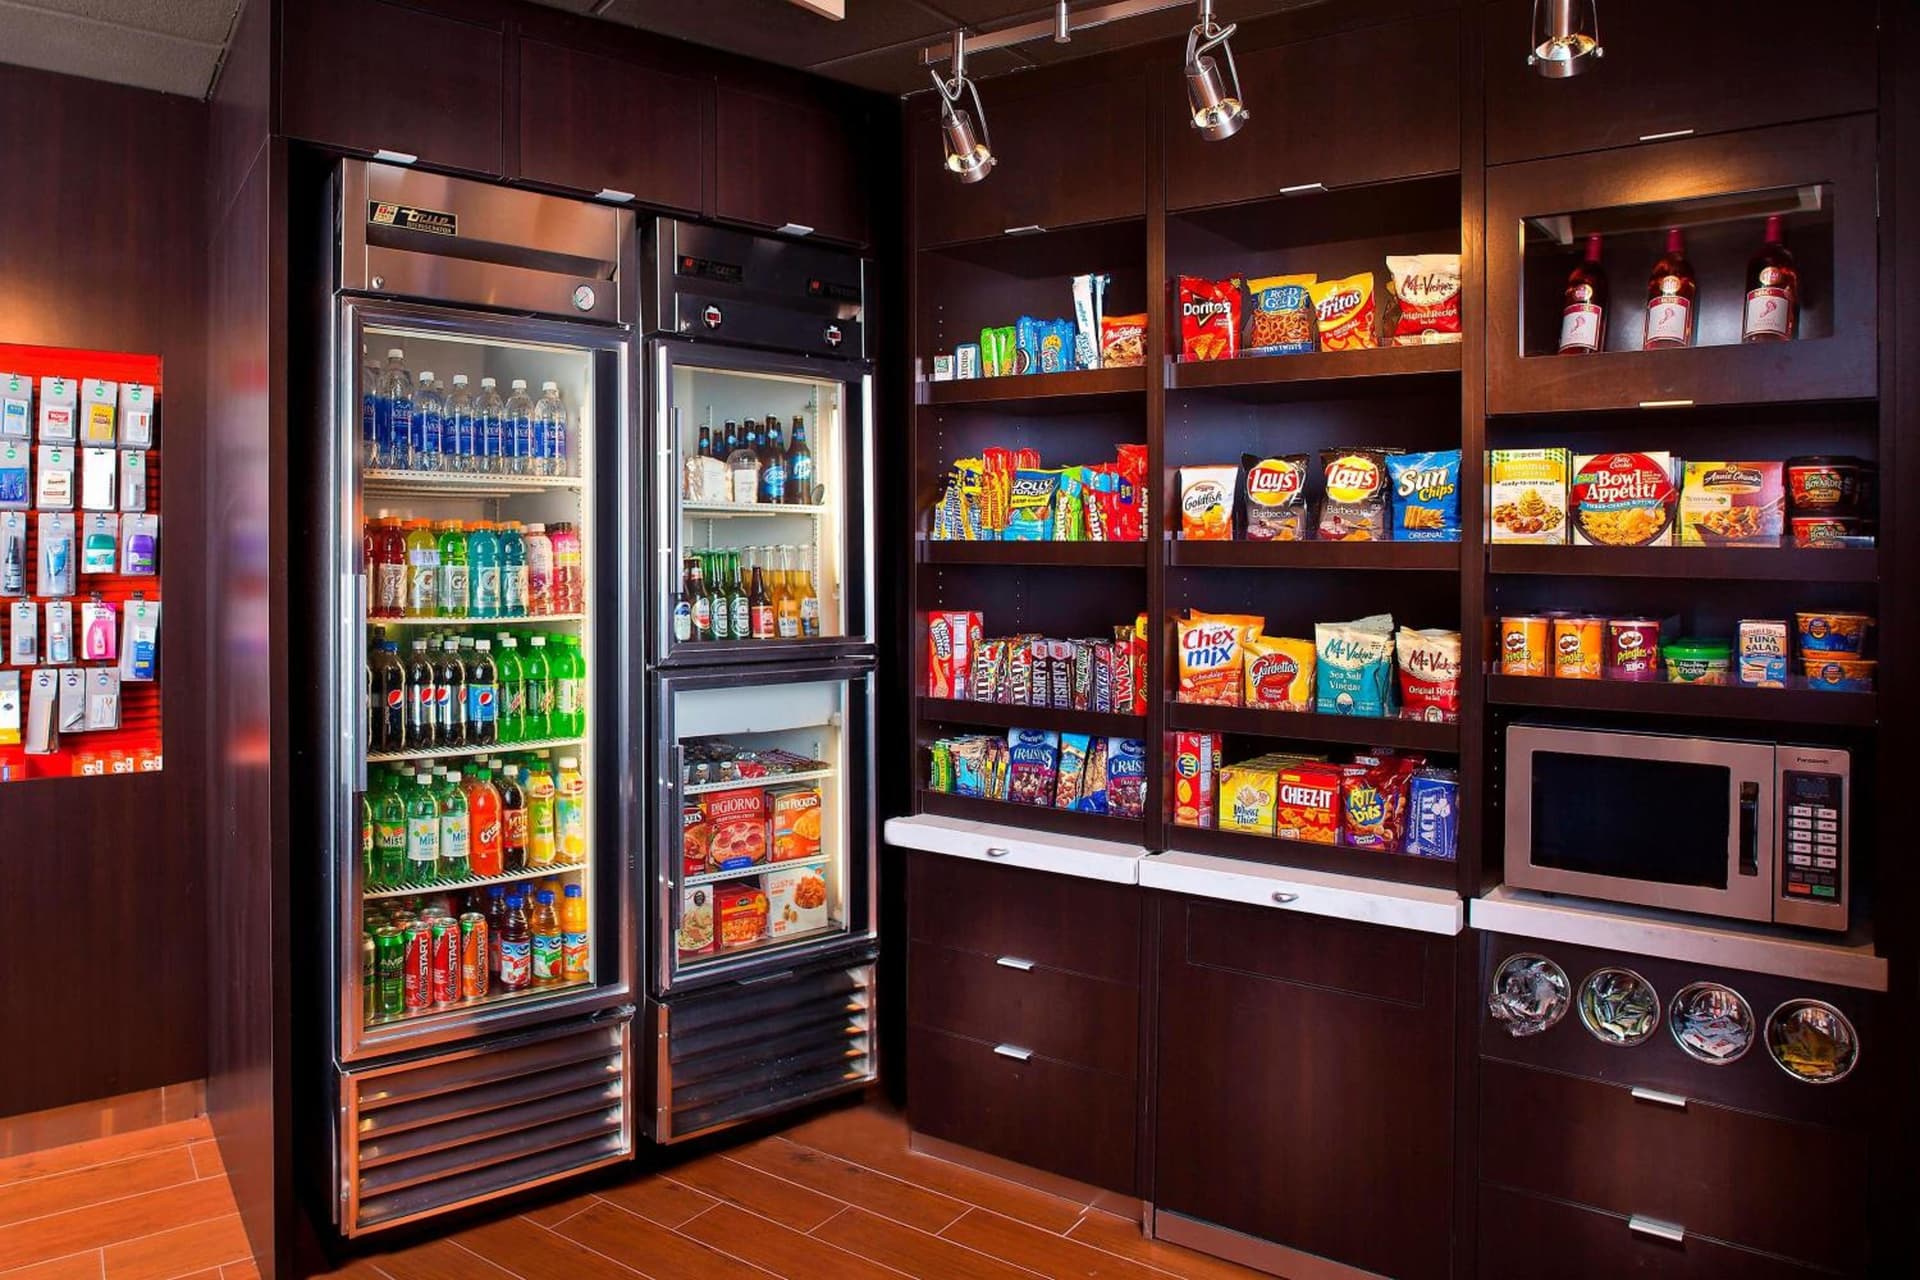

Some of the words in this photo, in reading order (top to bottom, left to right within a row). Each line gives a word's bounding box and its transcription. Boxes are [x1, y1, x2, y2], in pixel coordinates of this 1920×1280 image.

[1183, 301, 1231, 316] Doritos
[1317, 291, 1361, 321] Fritos
[1012, 479, 1051, 491] JOLLY
[1398, 468, 1450, 497] Sun
[1598, 470, 1643, 487] Bowl
[1184, 491, 1223, 511] Goldfish
[1418, 484, 1455, 502] Chips
[1327, 504, 1372, 517] Barbecue
[1408, 531, 1445, 540] ORIGINAL
[1183, 627, 1235, 650] Chex
[1748, 635, 1777, 644] TUNA
[1187, 643, 1235, 667] mix
[1745, 643, 1780, 653] SALAD
[1617, 649, 1647, 665] Pringles
[1032, 660, 1047, 705] ERSHEY'S
[1329, 671, 1345, 679] Sea
[1053, 661, 1068, 708] ERSHEY'S
[1281, 785, 1333, 809] CHEEZ-IT
